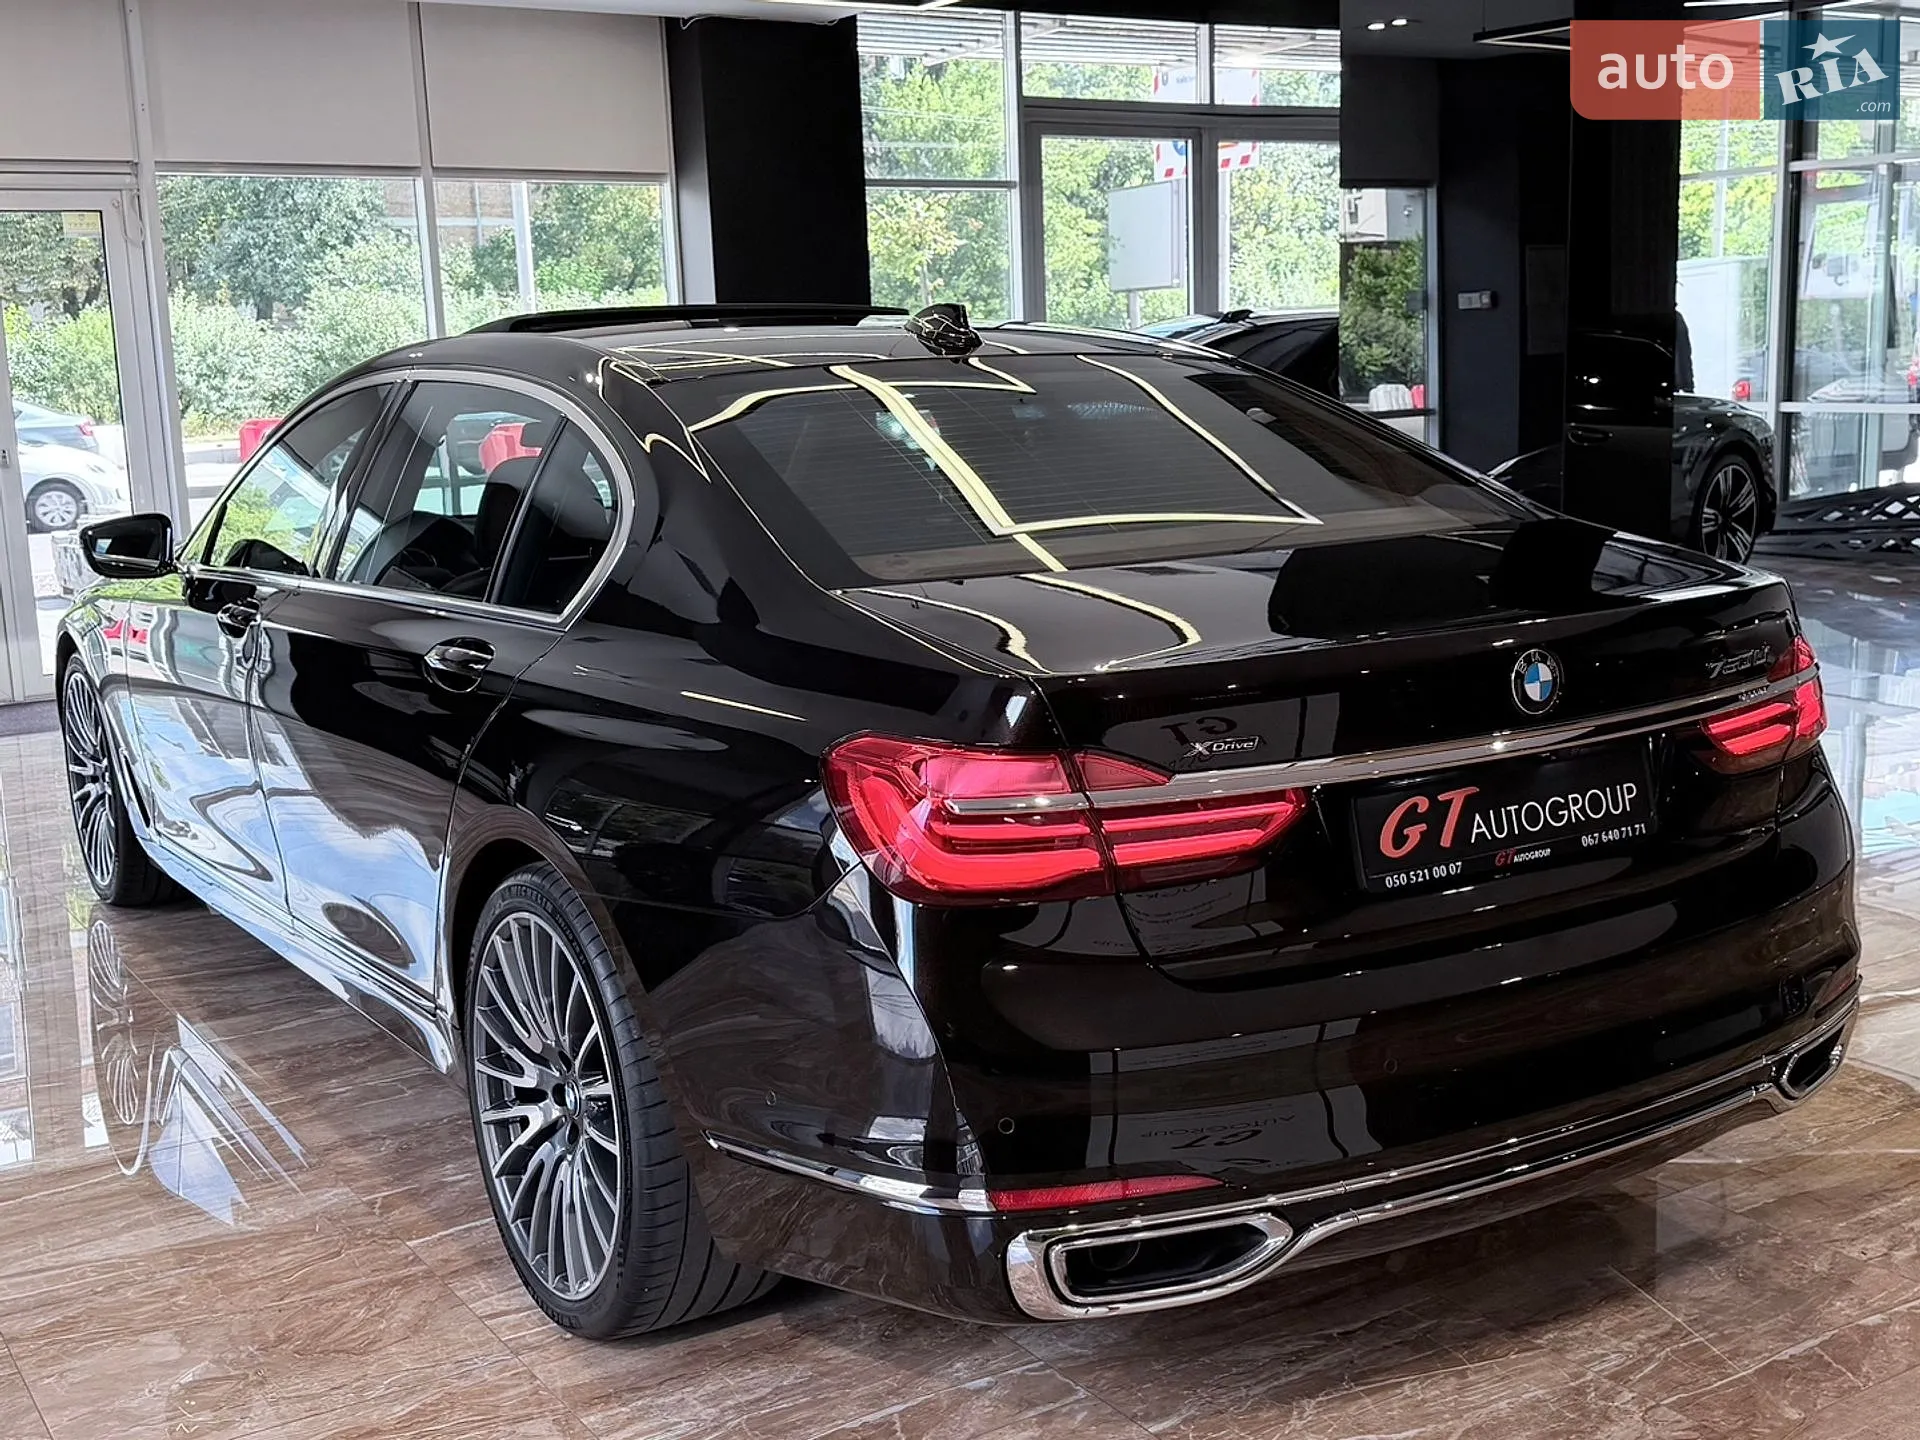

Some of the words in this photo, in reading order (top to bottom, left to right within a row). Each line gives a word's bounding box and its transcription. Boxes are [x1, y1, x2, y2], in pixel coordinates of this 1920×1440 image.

[1380, 786, 1480, 859] GT
[1470, 782, 1637, 844] AUTOGROUP
[1581, 832, 1600, 847] 067
[1601, 828, 1620, 843] 640
[1620, 826, 1633, 839] 71
[1634, 823, 1646, 836] 71
[1494, 847, 1517, 867] GT
[1513, 847, 1552, 864] AUTOGROUP
[1385, 872, 1407, 889] 050
[1409, 868, 1430, 884] 521
[1432, 864, 1447, 879] 00
[1448, 861, 1463, 876] 07
